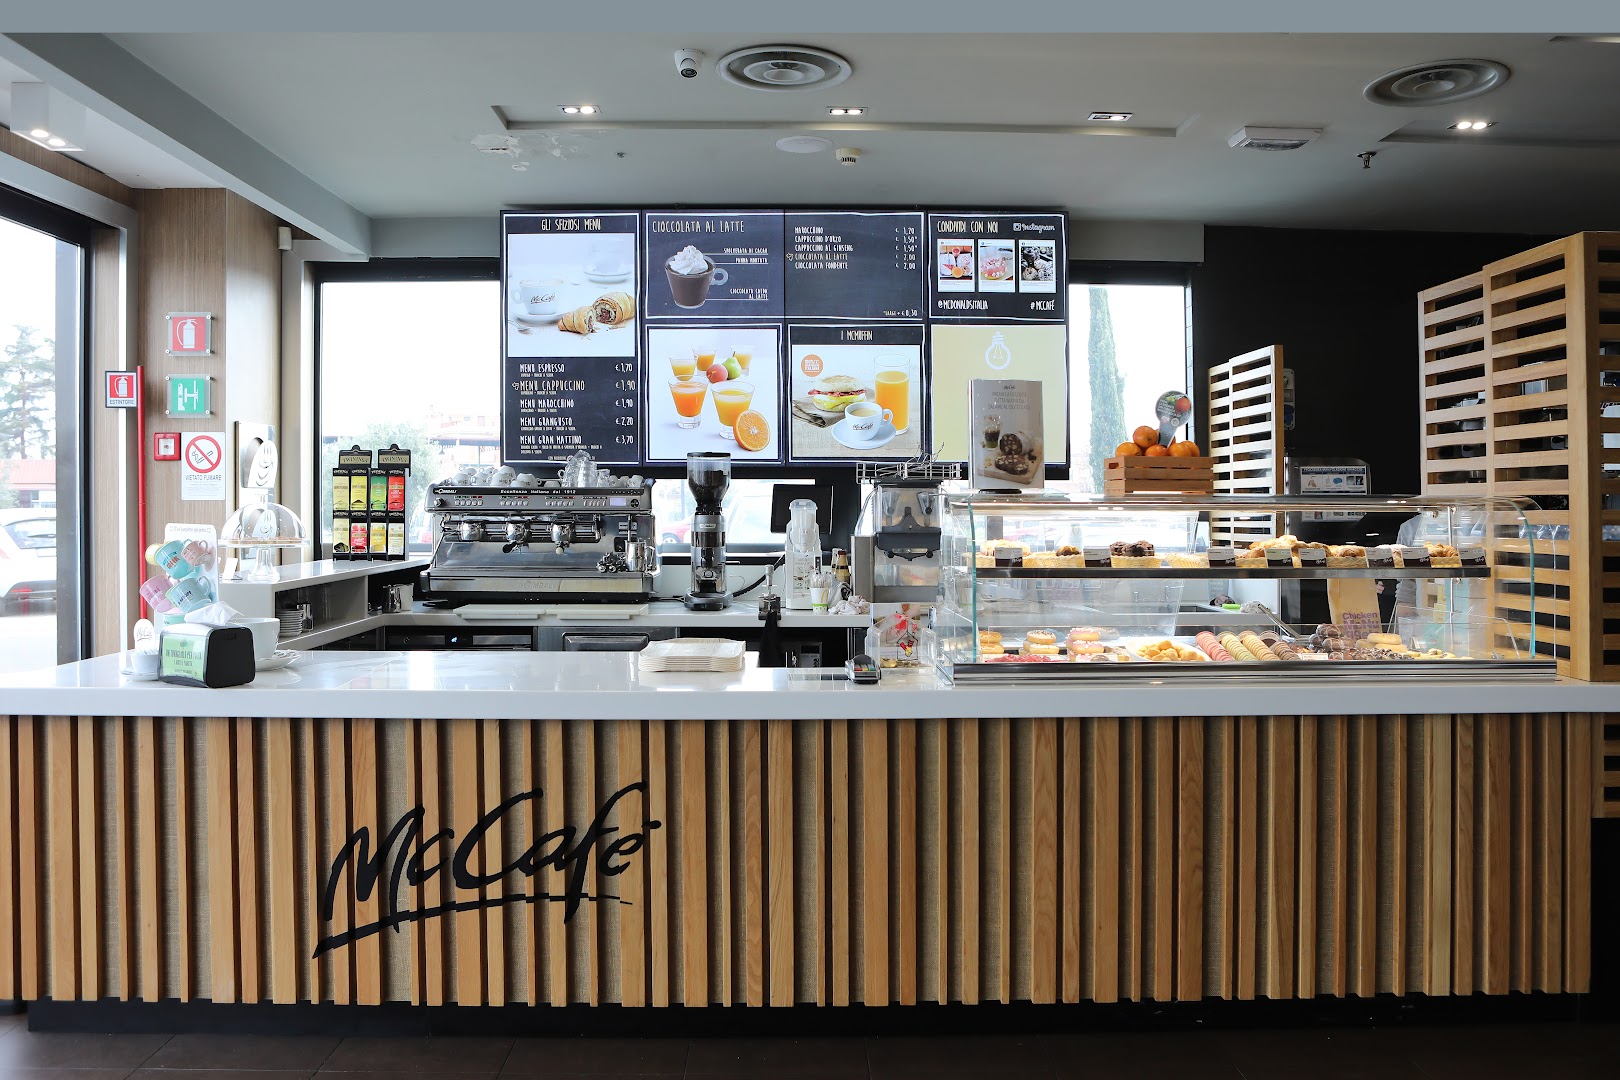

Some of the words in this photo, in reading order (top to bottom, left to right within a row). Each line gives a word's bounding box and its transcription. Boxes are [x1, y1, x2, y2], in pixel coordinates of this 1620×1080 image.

[541, 219, 551, 231] GLI
[652, 220, 702, 233] CIOCCOLATA
[705, 221, 716, 233] AL
[720, 220, 745, 233] LATTE
[937, 220, 967, 233] CONDIVIDI
[970, 220, 984, 233] CON
[986, 220, 999, 233] NOI
[1022, 223, 1056, 234] Instagram
[903, 227, 915, 235] 1,20
[795, 235, 824, 243] CAPPUCCINO
[795, 244, 824, 252] CAPPUCCINO
[825, 244, 832, 252] AL
[833, 244, 854, 252] GINSENG
[795, 253, 824, 261] CIOCCOLATA
[825, 253, 832, 261] AL
[833, 253, 848, 261] LATTE
[903, 253, 916, 262] 2,00
[795, 261, 824, 270] CIOCCOLATA
[825, 261, 848, 270] FONDENTE
[903, 262, 916, 271] 2,00
[937, 299, 989, 310] @MCDONALDSITALIA
[519, 363, 536, 373] MENU
[538, 363, 565, 373] ESPRESSO
[519, 380, 538, 391] MENU
[541, 380, 585, 391] CAPPUCCINO
[520, 399, 536, 409] MENU
[538, 399, 575, 409] MAROCCHINO
[520, 417, 536, 427] MENU
[538, 417, 573, 427] GRANGUSTO
[520, 435, 536, 444] MENU
[538, 435, 554, 444] GRAN
[556, 435, 582, 444] MATTINO
[1342, 611, 1379, 620] Chicken
[315, 781, 662, 950] McCafé
